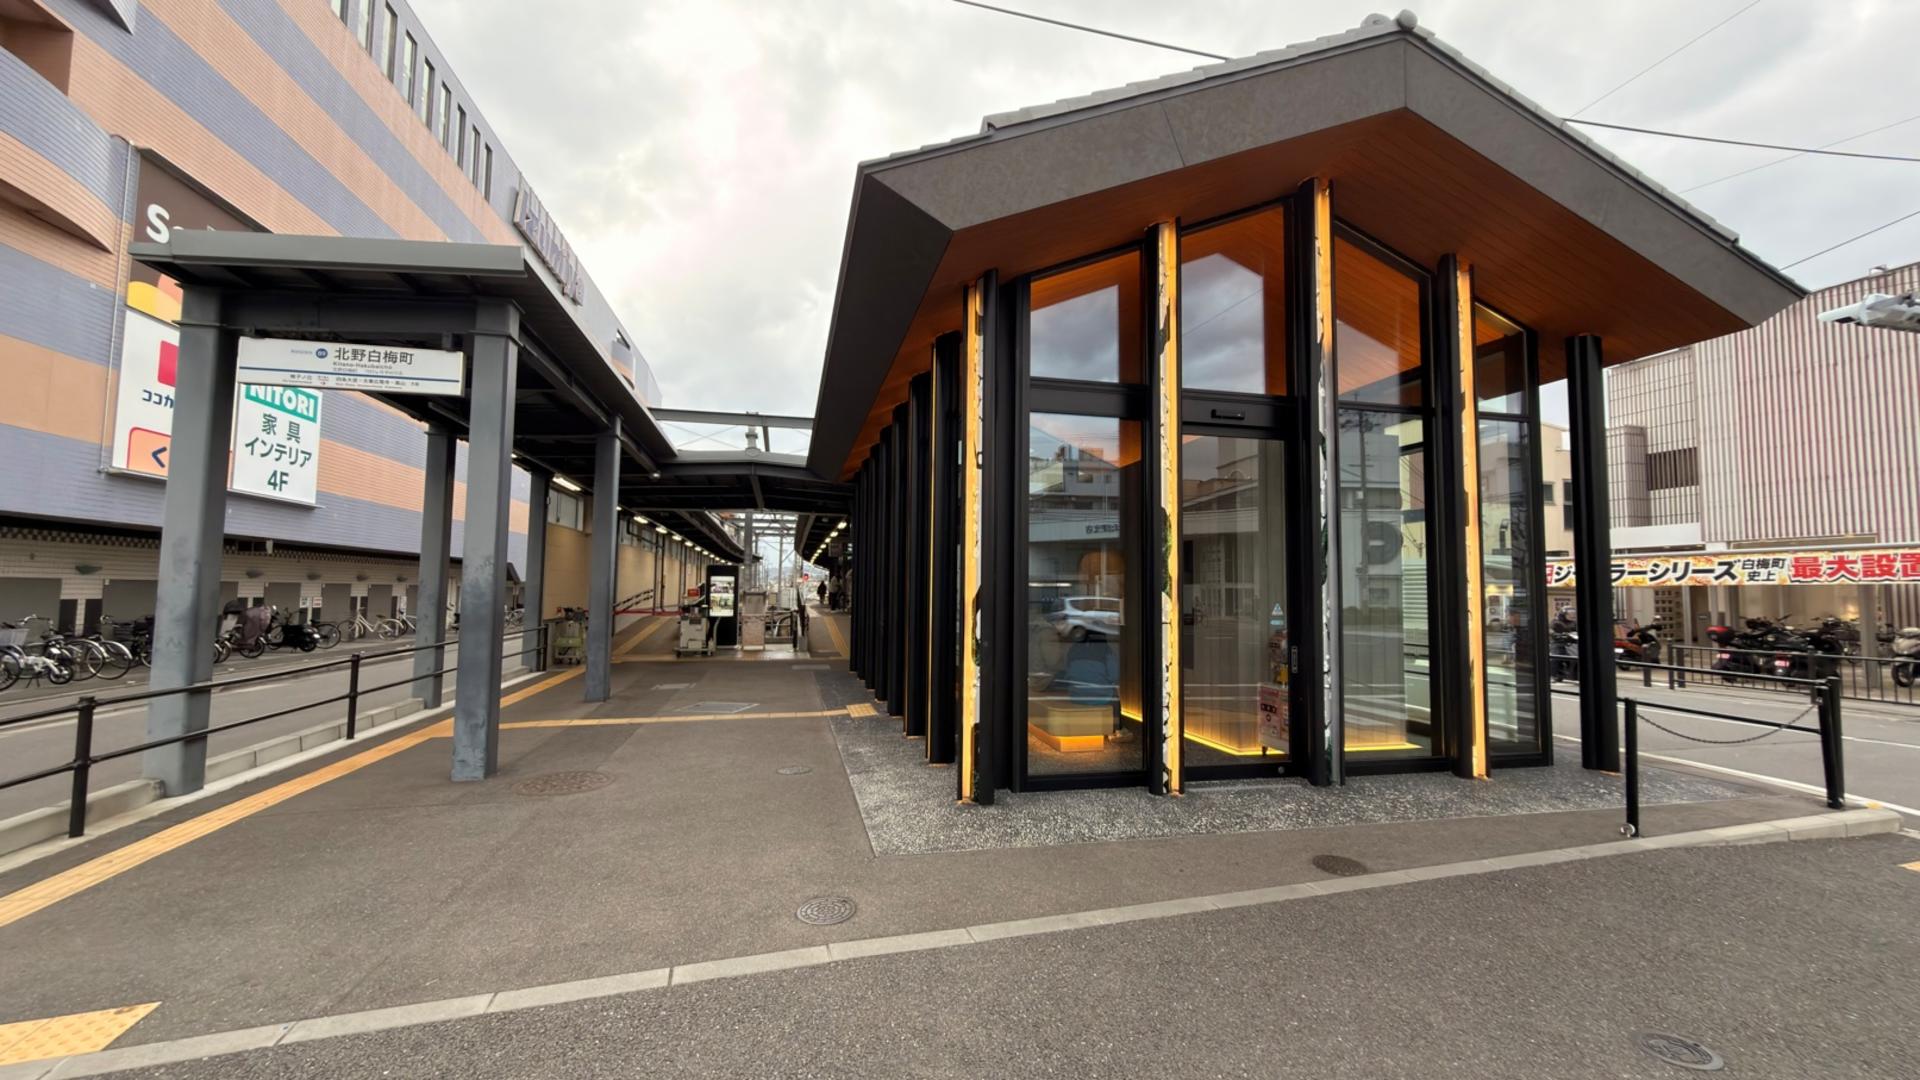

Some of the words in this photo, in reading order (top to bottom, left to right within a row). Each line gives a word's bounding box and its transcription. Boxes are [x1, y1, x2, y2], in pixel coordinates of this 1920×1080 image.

[334, 347, 415, 366] 北野白梅町
[250, 385, 315, 417] NITORI
[261, 412, 301, 443] 家具
[151, 446, 167, 468] く
[245, 436, 312, 468] インテリア
[267, 469, 289, 492] 4F
[1742, 557, 1786, 570] 白梅町
[1746, 570, 1776, 582] 史上
